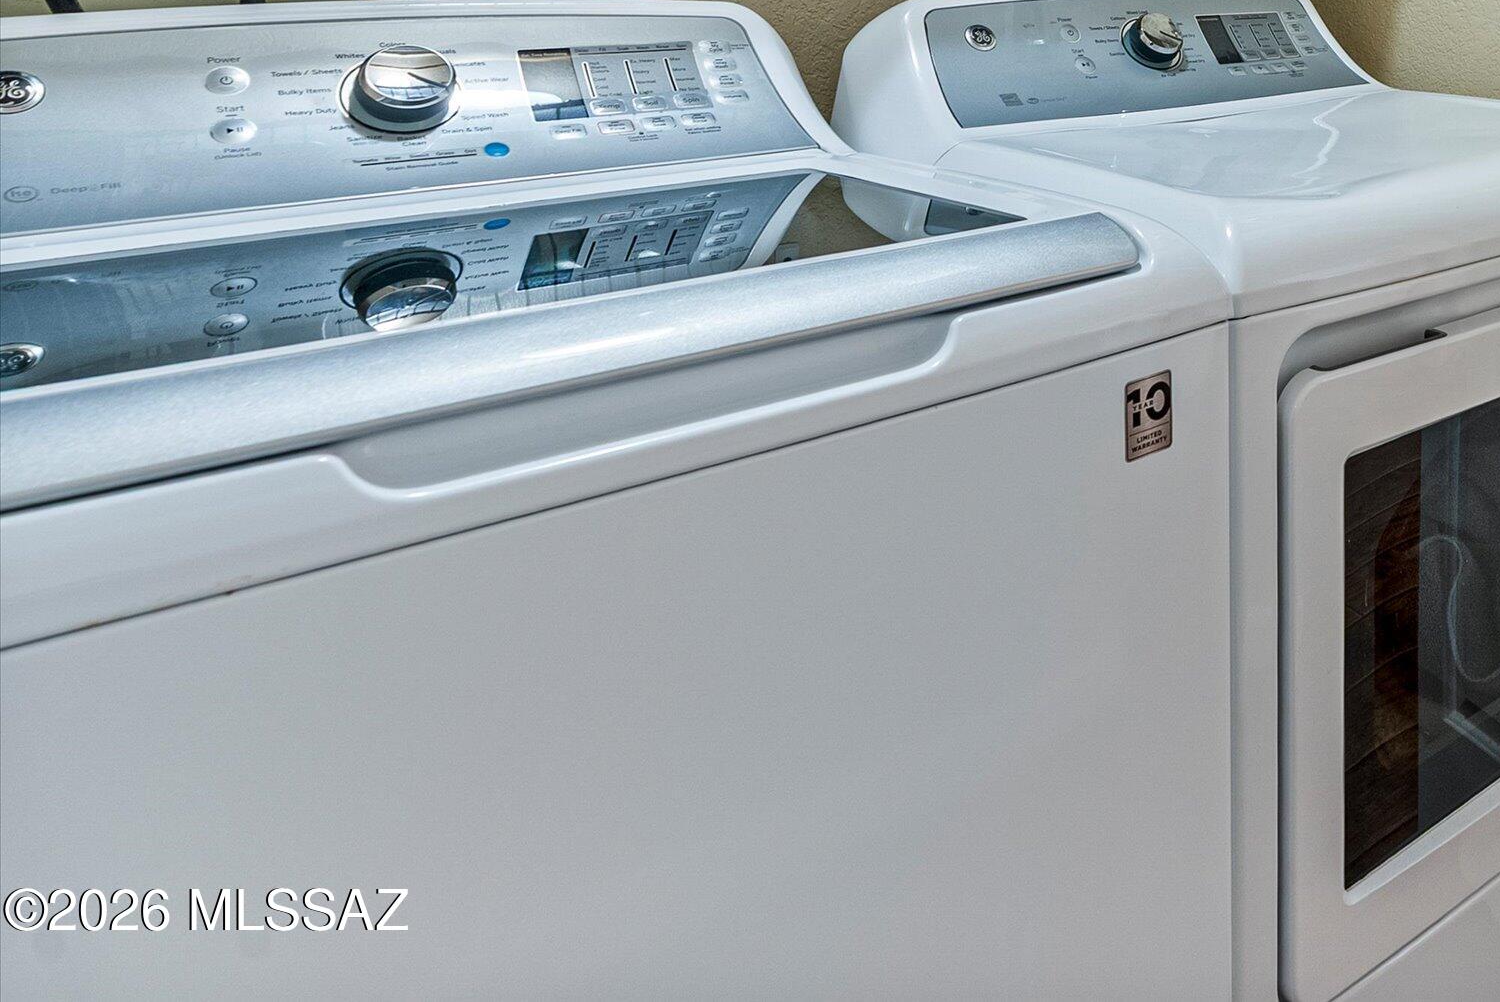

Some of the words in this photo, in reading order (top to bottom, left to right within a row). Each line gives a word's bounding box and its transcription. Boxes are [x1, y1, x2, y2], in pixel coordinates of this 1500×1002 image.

[206, 56, 241, 64] Power
[216, 105, 245, 113] Start
[51, 186, 88, 194] Deep
[1127, 381, 1171, 428] 10
[1133, 399, 1154, 411] YEAR
[1136, 429, 1162, 443] LIMITED
[1131, 436, 1167, 453] WARRANTY
